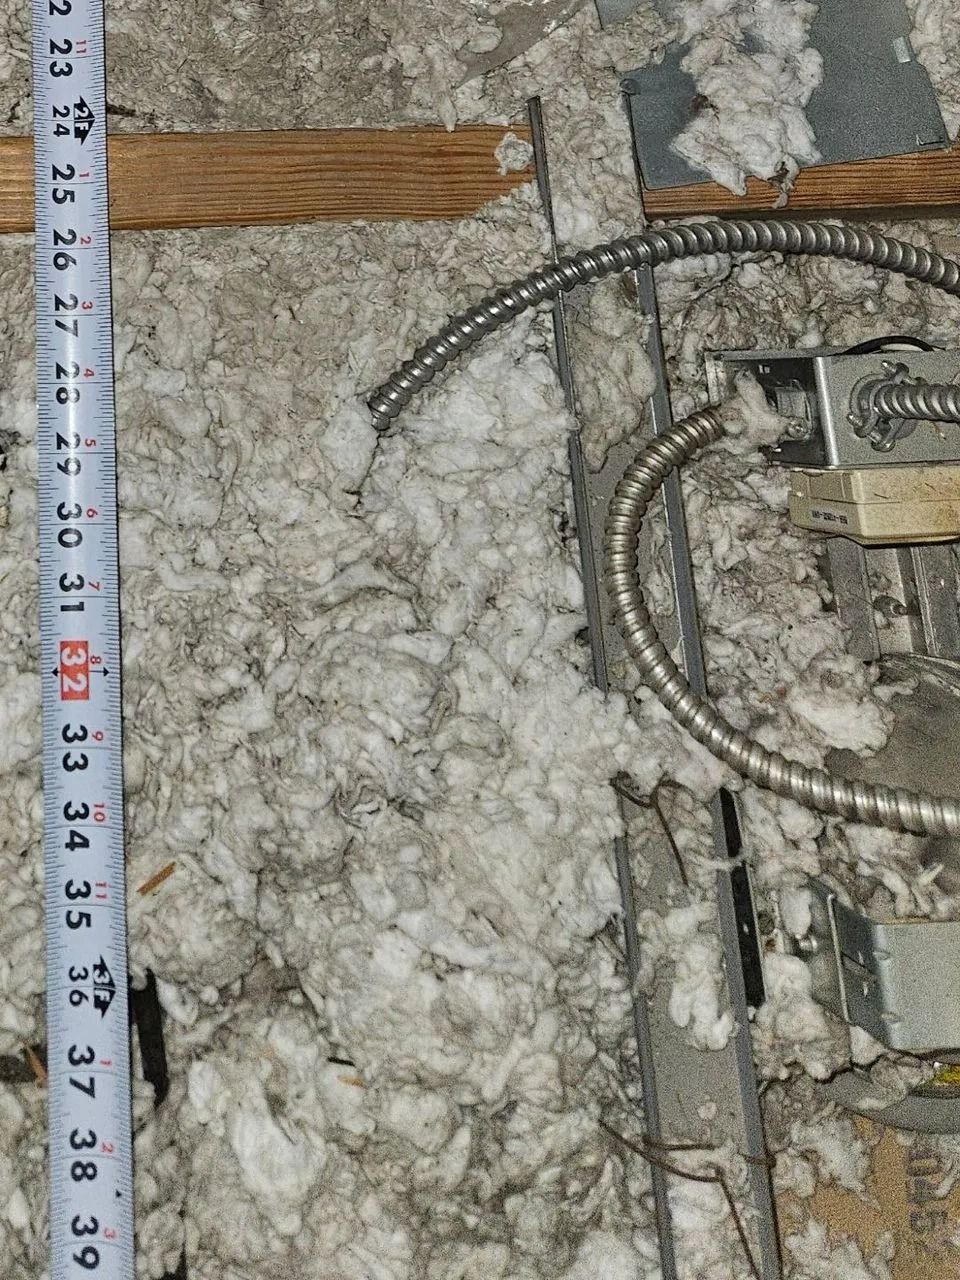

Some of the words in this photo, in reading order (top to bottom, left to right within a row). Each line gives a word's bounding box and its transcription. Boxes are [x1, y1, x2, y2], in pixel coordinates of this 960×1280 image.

[49, 38, 73, 77] 23
[76, 40, 87, 54] 11
[52, 105, 70, 137] 24
[52, 164, 76, 205] 25
[53, 228, 77, 271] 26
[80, 236, 92, 245] 2
[54, 293, 79, 337] 27
[82, 301, 93, 310] 3
[56, 361, 80, 405] 28
[83, 368, 94, 378] 4
[56, 432, 81, 476] 29
[85, 438, 96, 447] 5
[57, 501, 83, 548] 30
[86, 508, 98, 518] 6
[59, 572, 85, 612] 31
[88, 581, 100, 591] 7
[61, 647, 87, 693] 32
[90, 655, 101, 664] 8
[62, 723, 89, 772] 33
[92, 731, 103, 741] 9
[63, 800, 90, 851] 34
[93, 802, 106, 822] 10
[65, 879, 92, 929] 35
[95, 882, 107, 899] 11
[68, 965, 89, 1007] 36
[68, 1044, 96, 1099] 37
[69, 1127, 98, 1182] 38
[101, 1142, 114, 1153] 2
[71, 1214, 100, 1270] 39
[103, 1227, 116, 1239] 3
